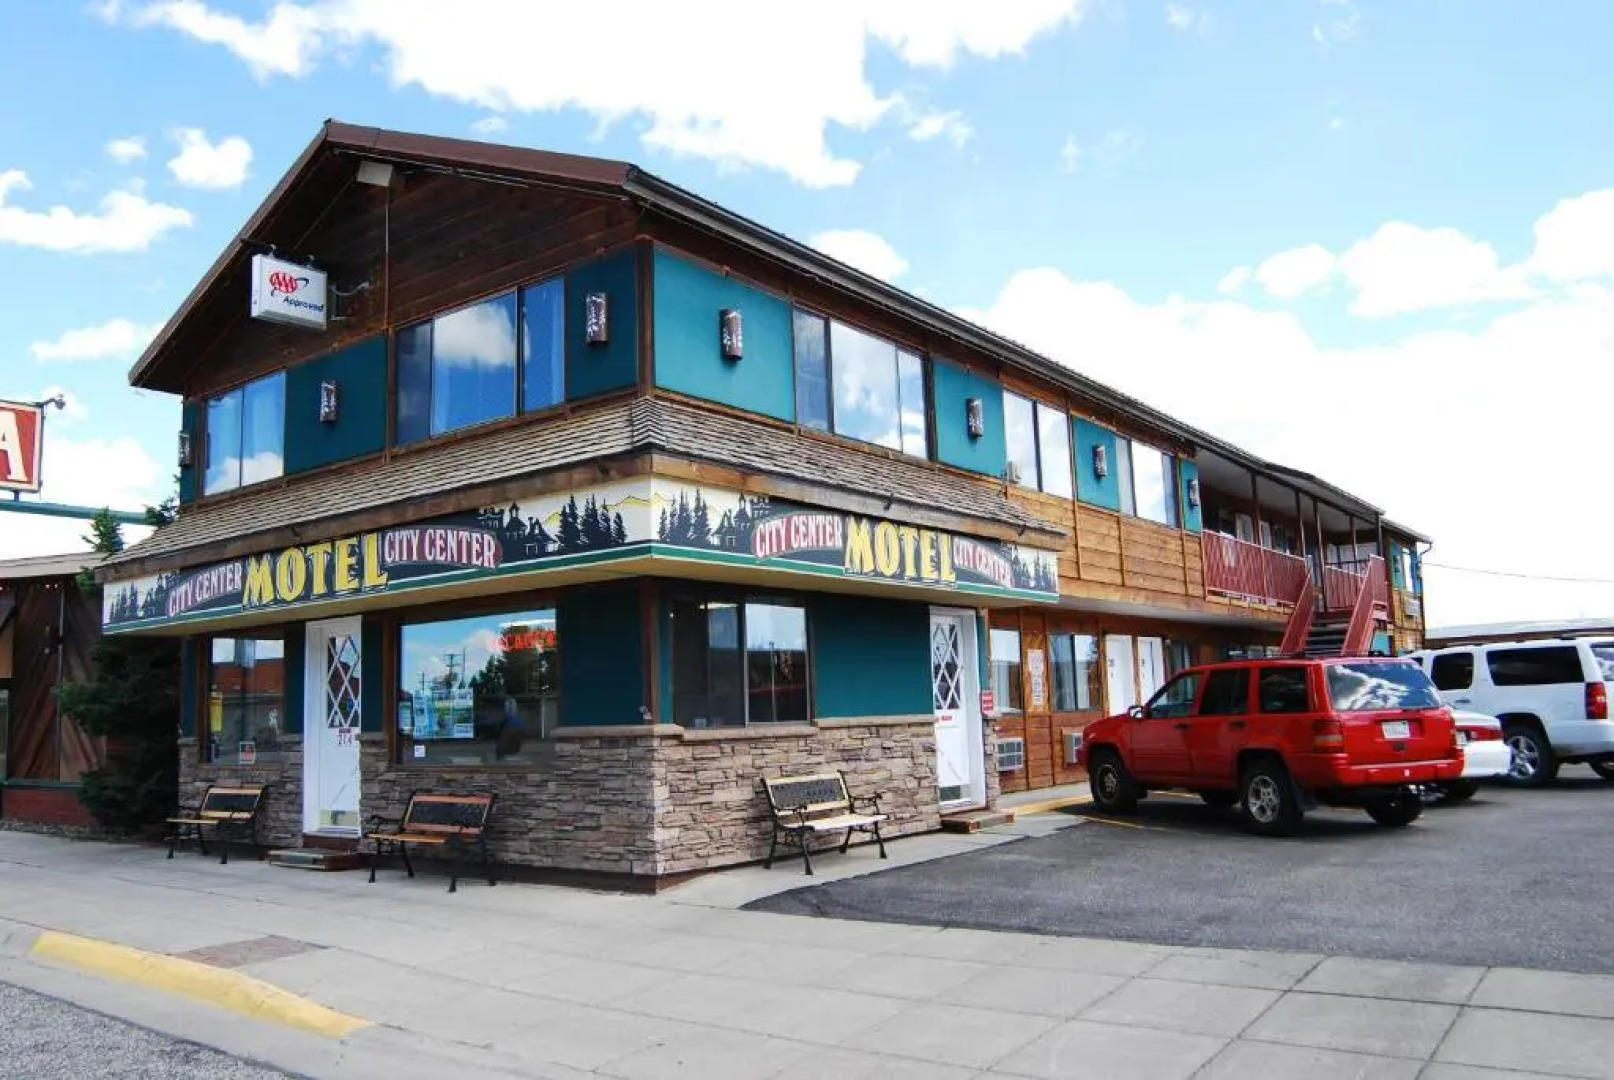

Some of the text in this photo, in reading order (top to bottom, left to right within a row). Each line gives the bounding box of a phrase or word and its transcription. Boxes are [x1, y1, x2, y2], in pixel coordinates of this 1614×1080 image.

[283, 295, 325, 313] Approved
[168, 528, 497, 618] CITY CENTER MOTEL CITY CENTER
[755, 513, 1015, 588] CITY CENTER MOTEL CITY CENTER
